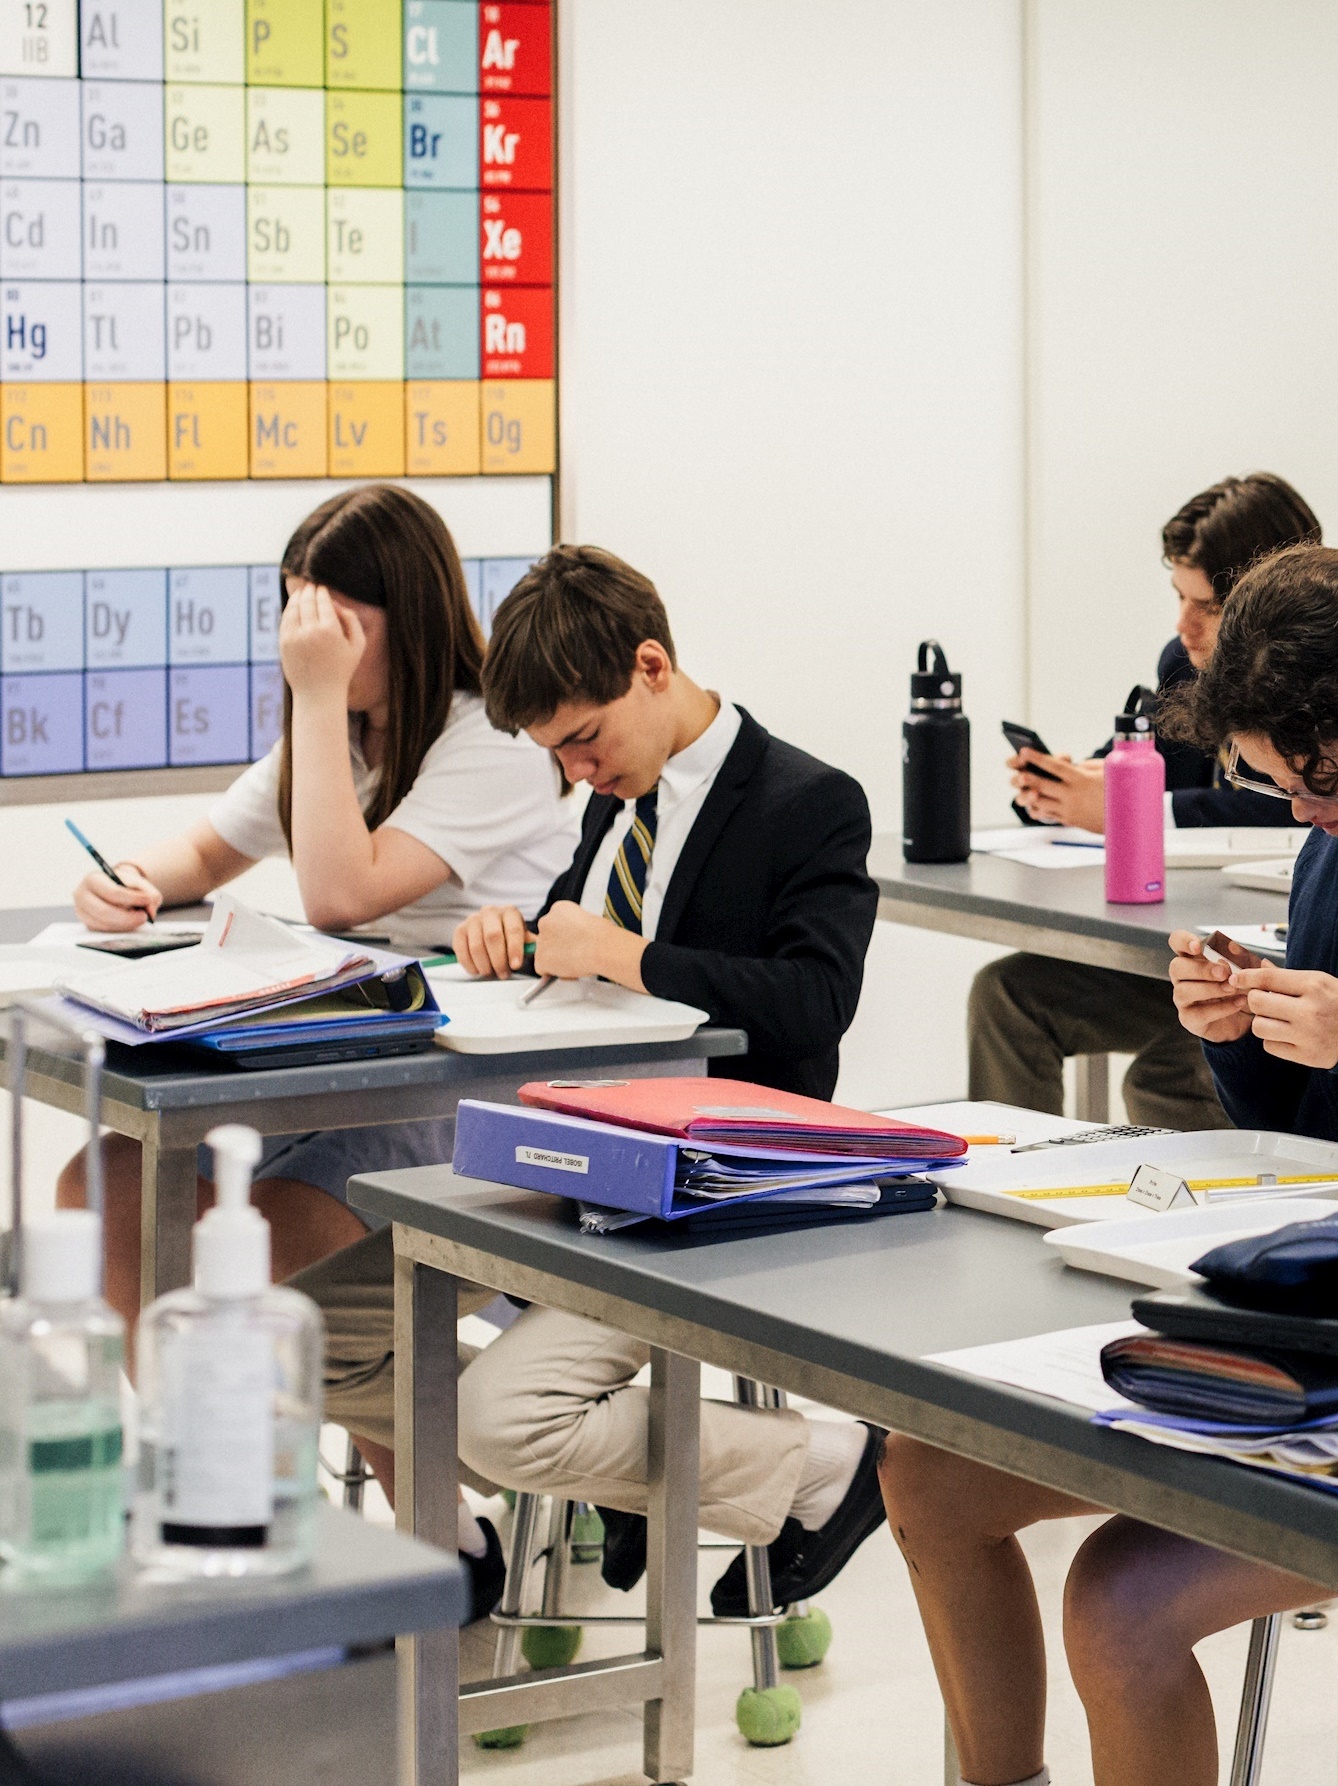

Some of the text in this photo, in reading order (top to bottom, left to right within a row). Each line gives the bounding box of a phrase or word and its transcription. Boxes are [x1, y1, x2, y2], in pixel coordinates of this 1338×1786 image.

[24, 3, 48, 29] 12
[87, 11, 120, 49] Al
[171, 16, 200, 52] Si
[253, 19, 270, 56] P
[331, 23, 348, 59] S
[406, 25, 440, 65] Cl
[481, 29, 520, 70] Ar
[4, 111, 40, 148] Zn
[88, 114, 127, 150] Ga
[171, 116, 209, 152] Ge
[252, 118, 289, 153] As
[332, 123, 367, 158] Se
[410, 124, 443, 159] Br
[483, 124, 520, 165] Kr
[6, 212, 45, 248] Cd
[90, 214, 118, 249] In
[173, 216, 210, 252] Sn
[254, 218, 291, 254] Sb
[334, 219, 363, 254] Te
[409, 221, 418, 255] I
[482, 219, 522, 260] Xe
[7, 315, 47, 360] Hg
[91, 316, 119, 351] Tl
[174, 316, 213, 351] Pb
[256, 316, 284, 350] Bi
[335, 317, 369, 350] Po
[411, 318, 442, 351] At
[485, 314, 527, 354] Rn
[5, 415, 48, 452] Cn
[91, 415, 131, 450] Nh
[175, 414, 202, 449] Fl
[256, 414, 298, 449] Mc
[335, 415, 368, 448] Lv
[414, 412, 448, 446] Ts
[487, 412, 521, 454] Og
[7, 606, 45, 642] Tb
[92, 602, 131, 645] Dy
[176, 599, 215, 636] Ho
[7, 708, 49, 745] Bk
[91, 701, 125, 738] Cf
[176, 698, 209, 734] Es
